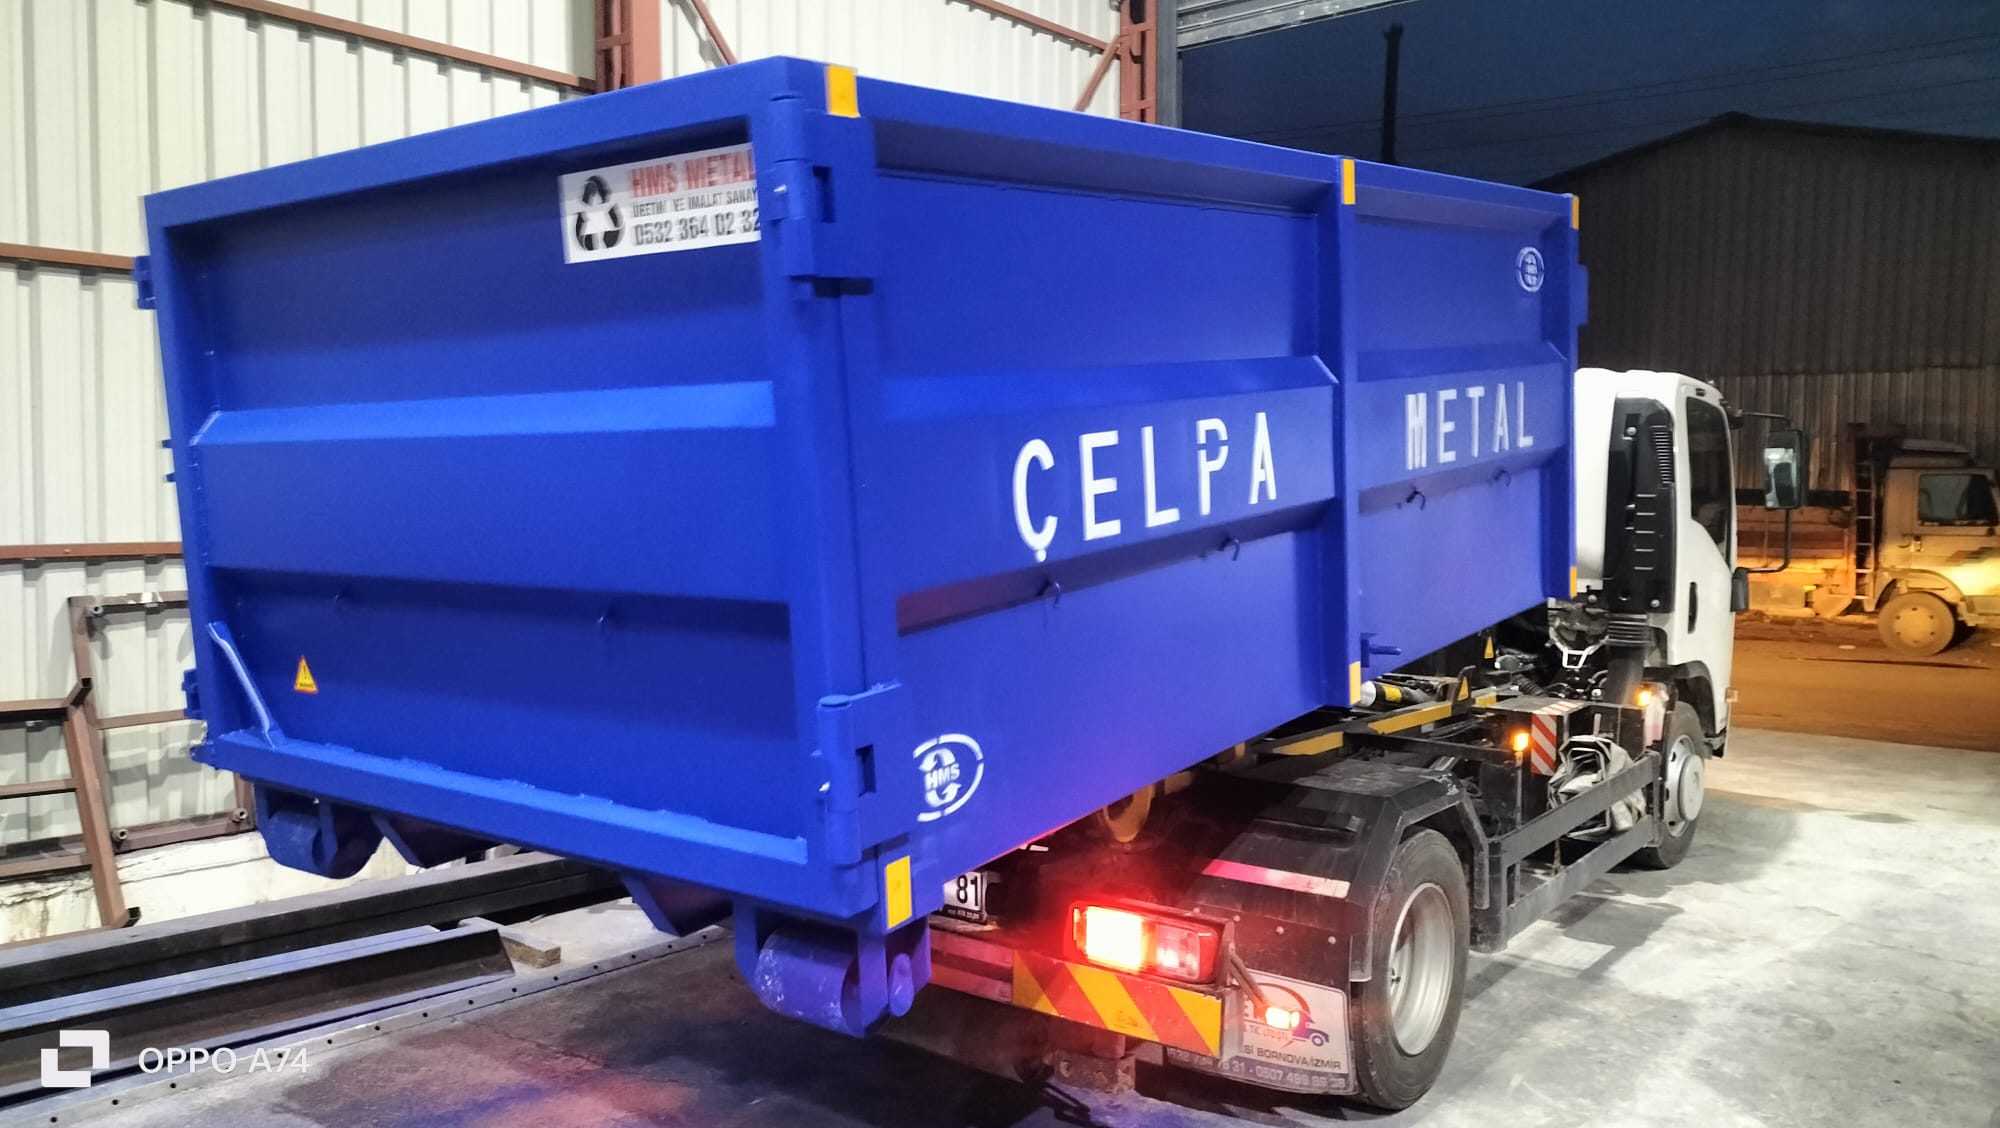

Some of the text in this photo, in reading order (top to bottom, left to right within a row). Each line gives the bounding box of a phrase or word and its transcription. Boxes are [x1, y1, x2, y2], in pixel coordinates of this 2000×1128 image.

[631, 162, 678, 197] HMS
[634, 220, 673, 246] 0532
[678, 214, 709, 241] 364
[714, 211, 737, 236] 02
[1012, 381, 1534, 563] ÇELPA METAL
[925, 763, 960, 790] HMS
[957, 874, 979, 906] 81
